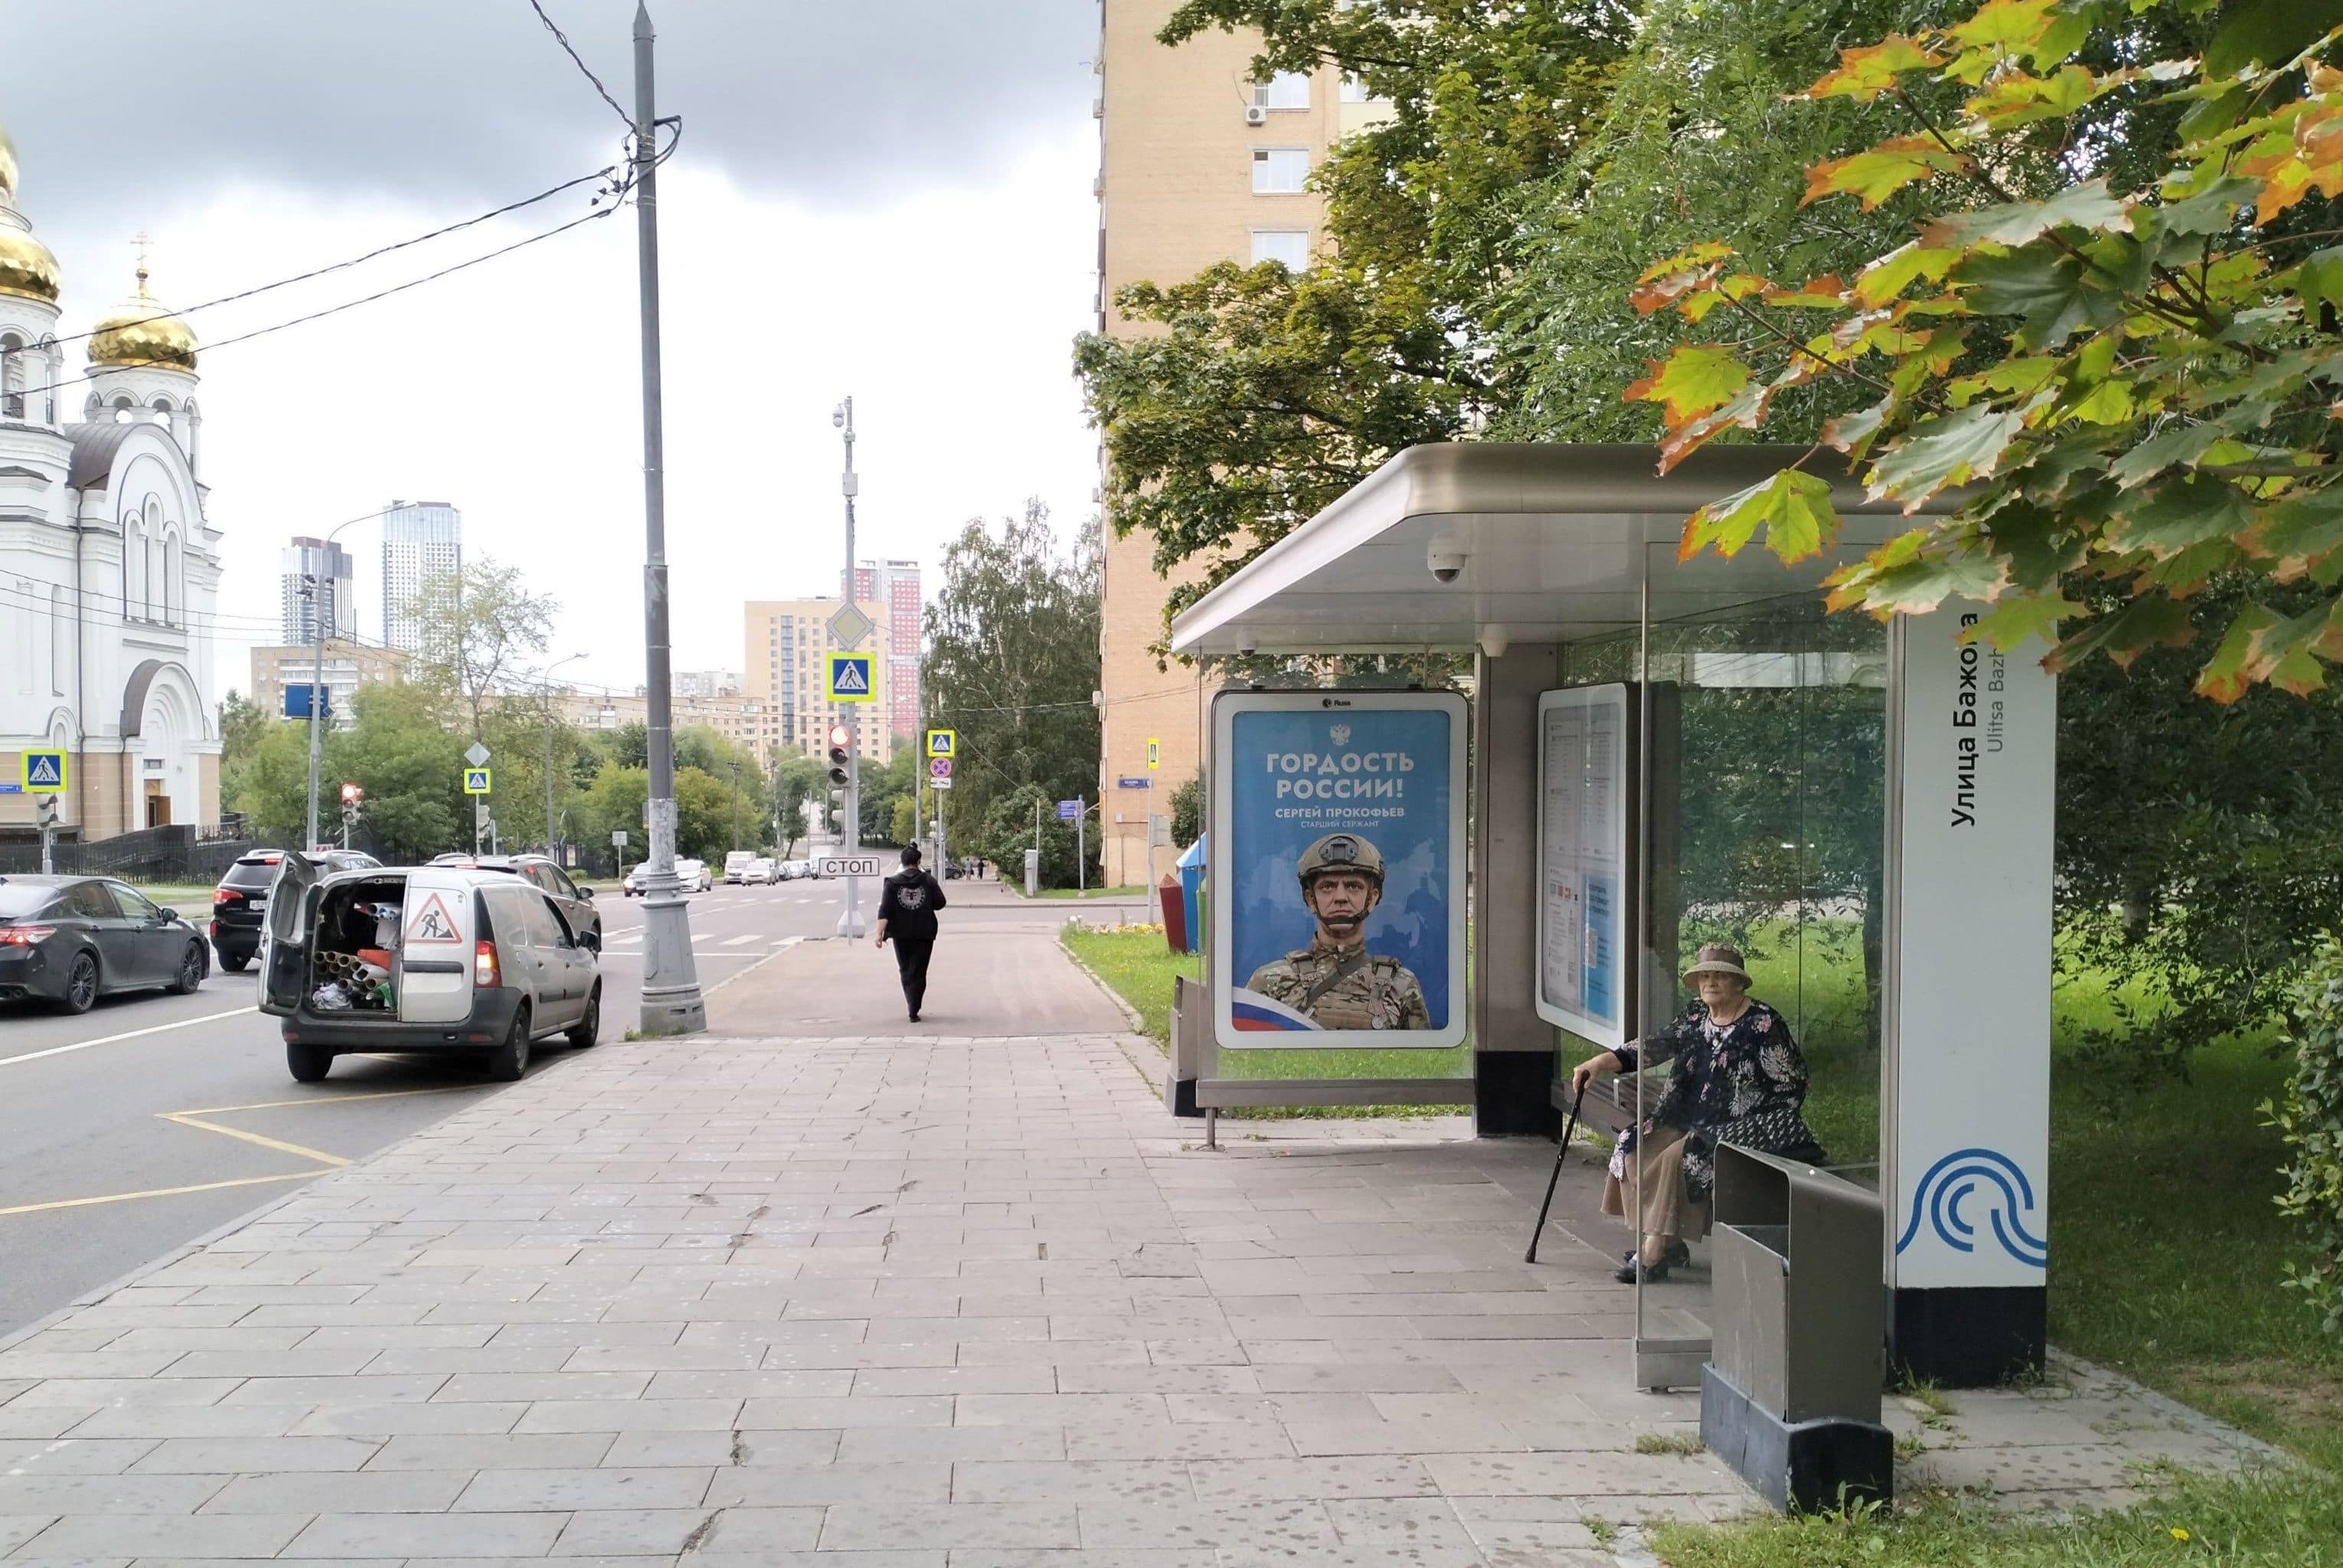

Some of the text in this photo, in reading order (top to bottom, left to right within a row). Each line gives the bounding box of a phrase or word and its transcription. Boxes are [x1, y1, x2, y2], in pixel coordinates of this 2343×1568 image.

[1986, 648, 2004, 753] Ulitsa Bazh
[1951, 612, 1979, 828] Улица Бажоа
[1266, 753, 1415, 775] ГОРДОСТЬ
[1276, 778, 1404, 799] РОССИИ!
[1275, 805, 1405, 818] СЕРГЕЙ ПРОКОФЬЕВ
[1301, 819, 1379, 828] СТАРШИЙ СЕРЖАНТ
[826, 861, 873, 874] СТОП
